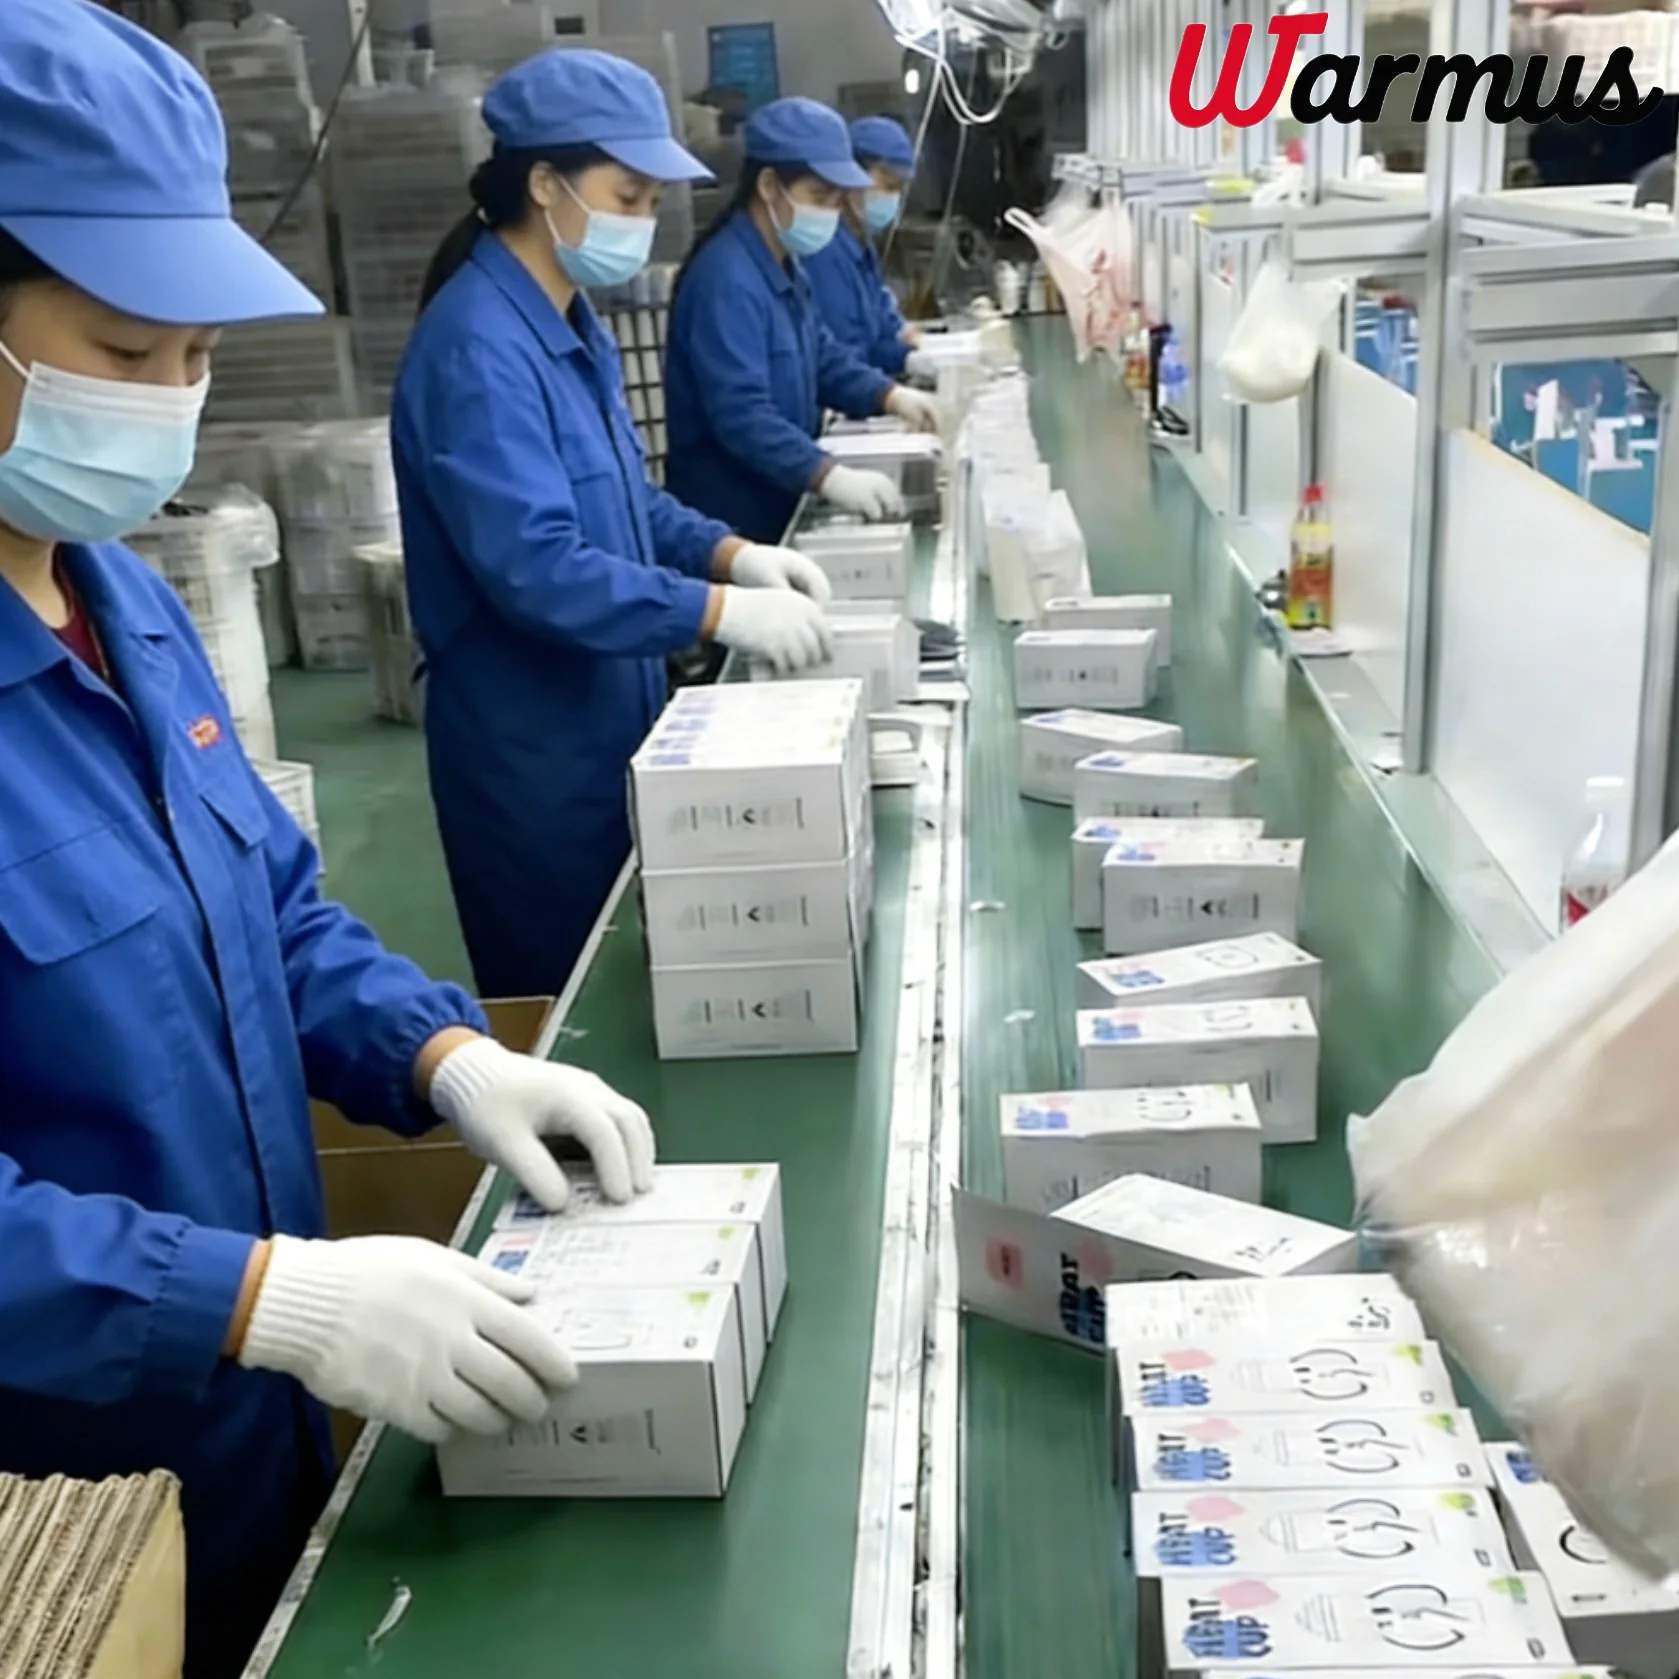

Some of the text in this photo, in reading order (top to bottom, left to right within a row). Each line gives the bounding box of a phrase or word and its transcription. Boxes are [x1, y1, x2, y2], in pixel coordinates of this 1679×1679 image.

[1201, 1447, 1232, 1480] CUP
[1157, 1512, 1192, 1565] HEAT
[1203, 1526, 1237, 1565] CUP
[1185, 1598, 1225, 1657] HEAT
[1236, 1615, 1273, 1658] CUP
